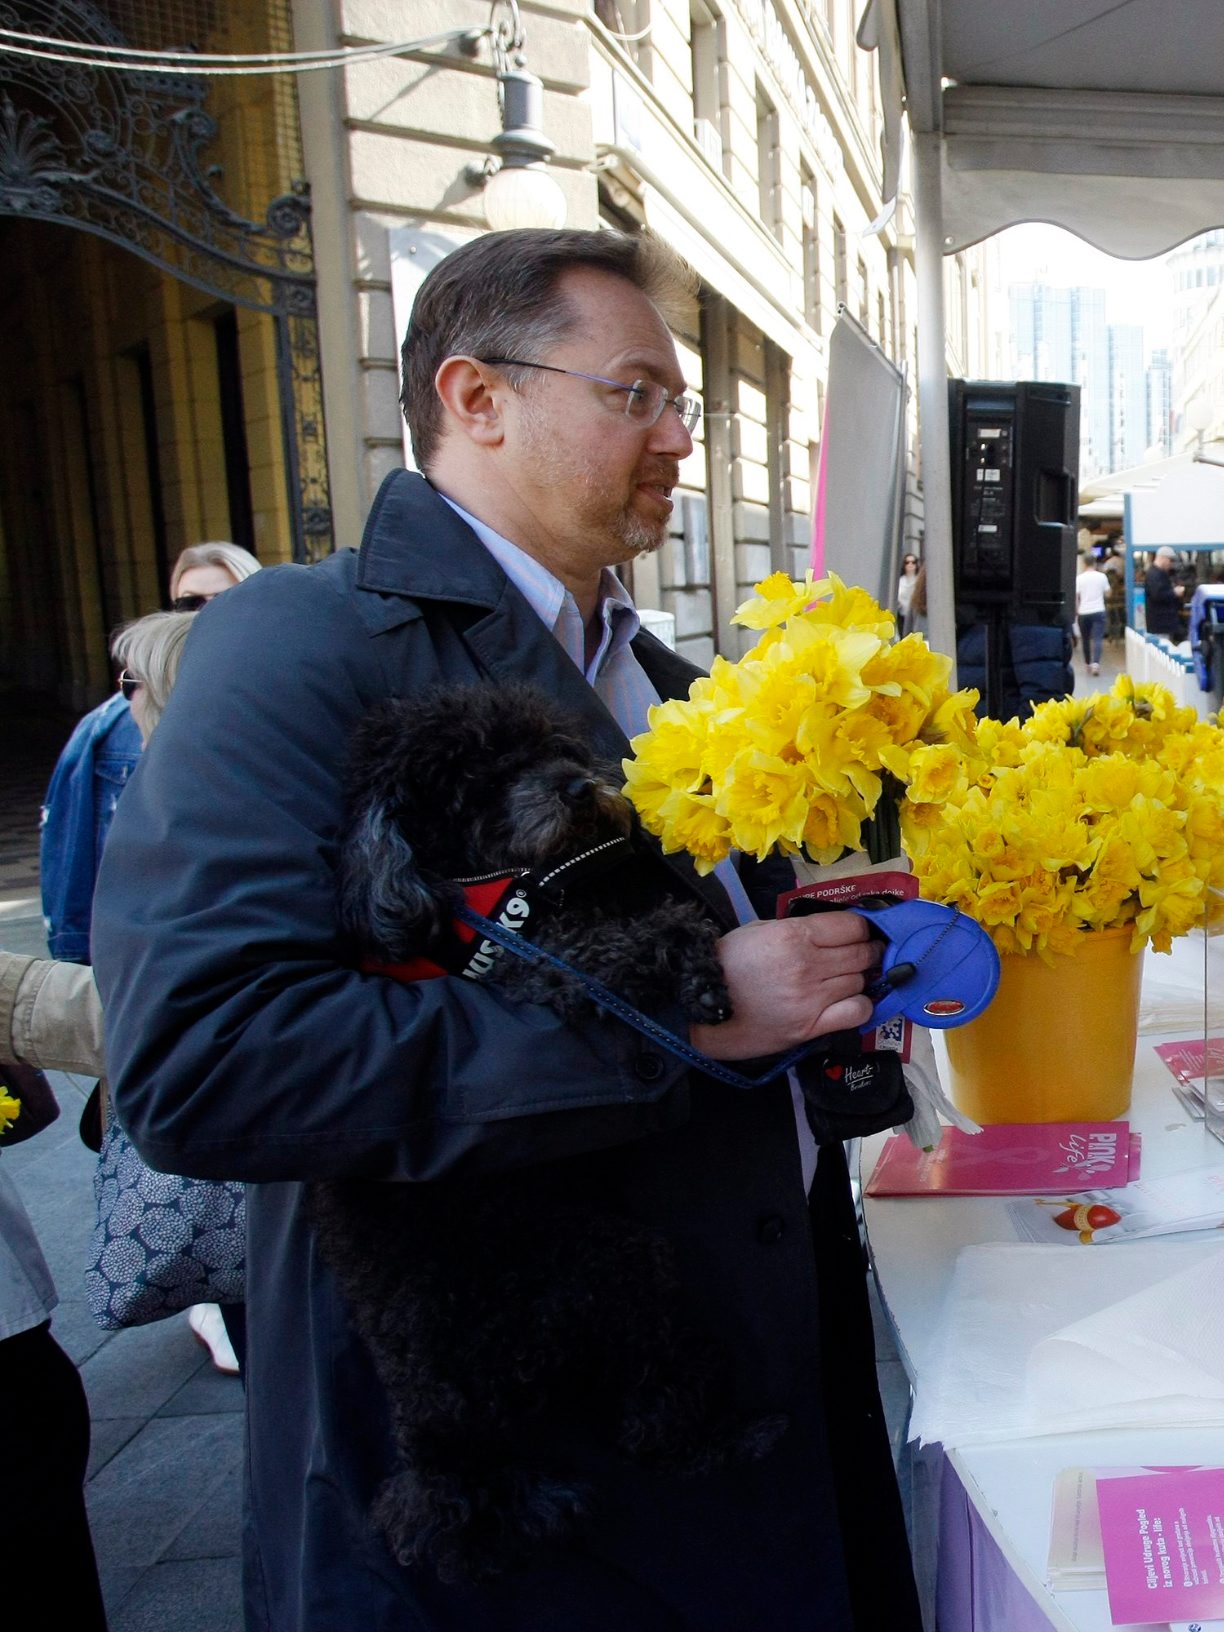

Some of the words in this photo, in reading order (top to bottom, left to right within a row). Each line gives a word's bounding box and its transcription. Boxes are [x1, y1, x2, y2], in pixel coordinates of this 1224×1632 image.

[1087, 1133, 1117, 1166] PINK
[1136, 1508, 1149, 1535] Pogled
[1143, 1535, 1154, 1564] Udruge
[1156, 1537, 1167, 1555] kuta
[1145, 1564, 1159, 1589] Ciljevi
[1161, 1555, 1172, 1579] novog
